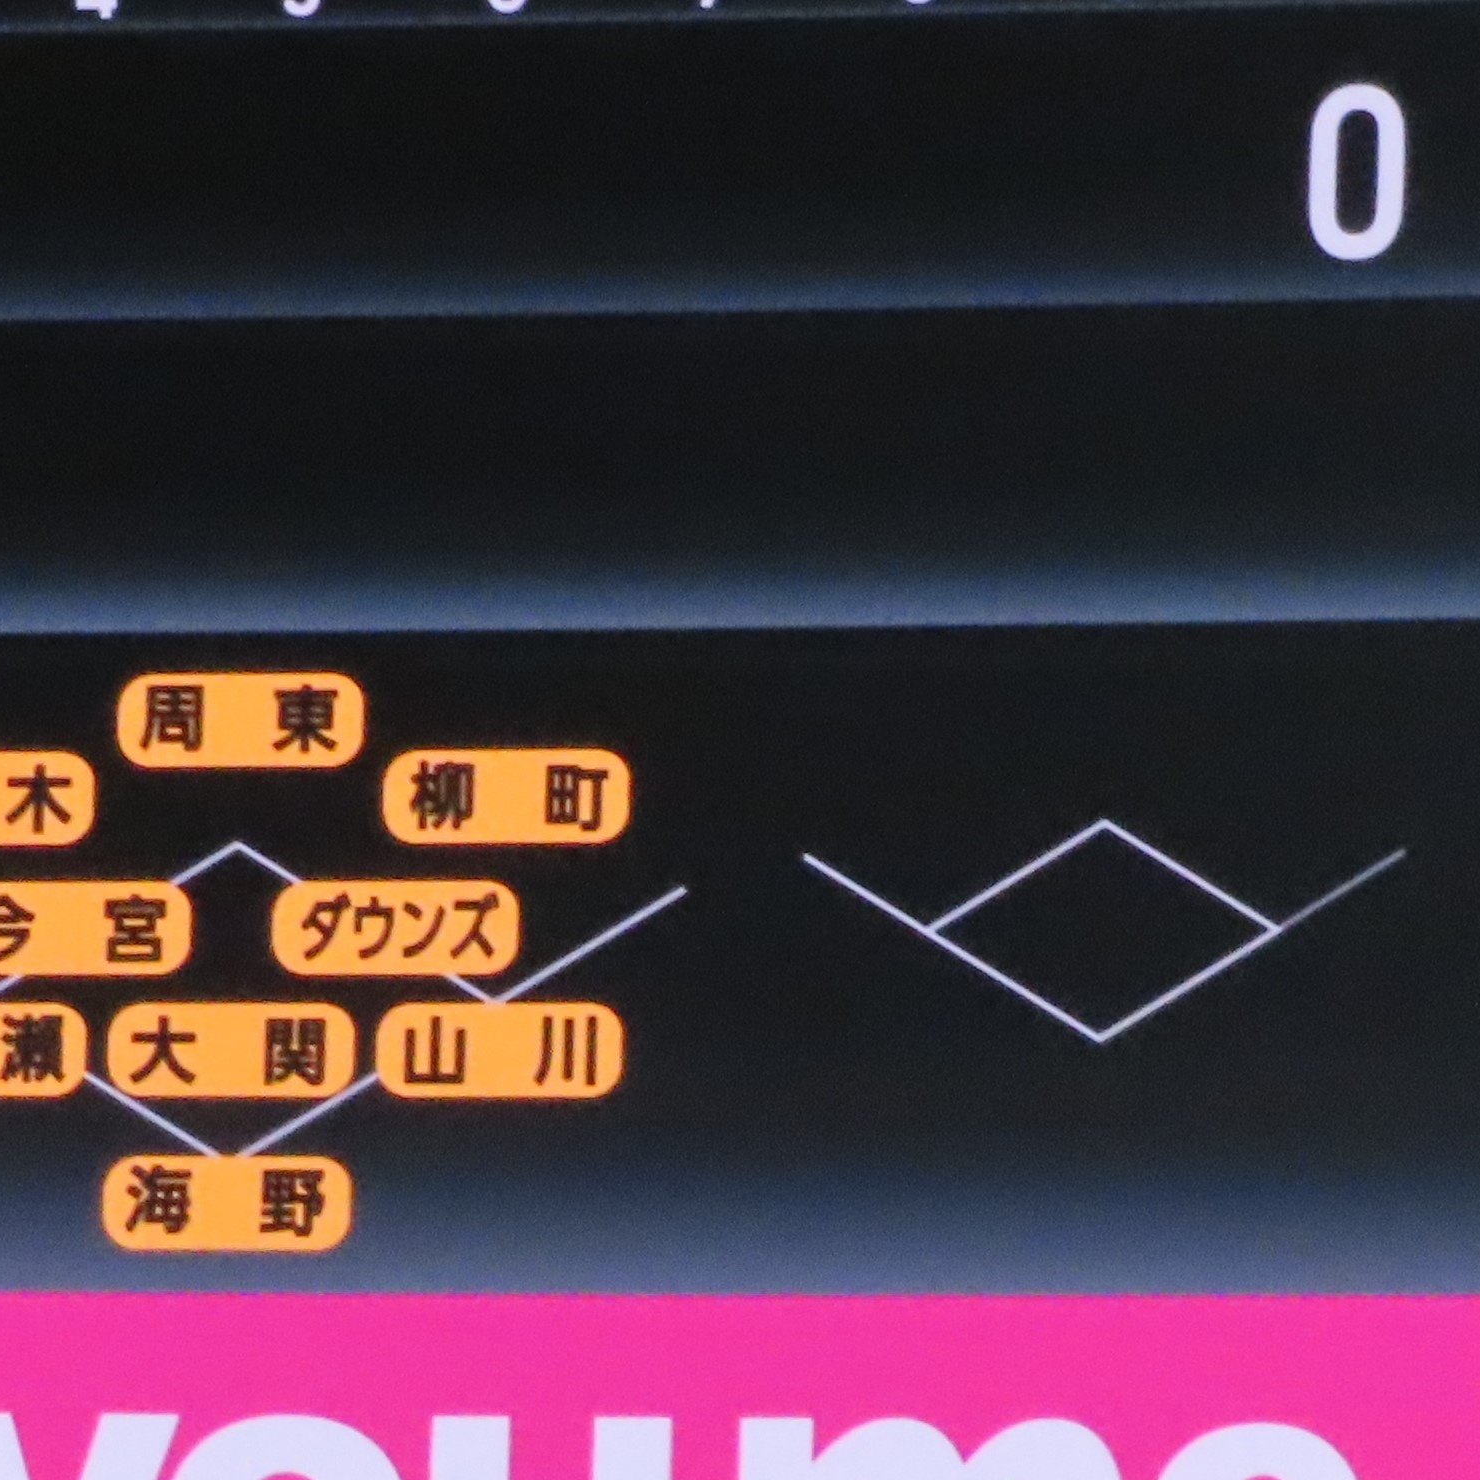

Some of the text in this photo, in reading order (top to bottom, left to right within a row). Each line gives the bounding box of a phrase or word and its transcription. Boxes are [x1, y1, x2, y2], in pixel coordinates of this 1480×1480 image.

[1308, 83, 1406, 261] 0
[301, 892, 500, 960] ダウンズ
